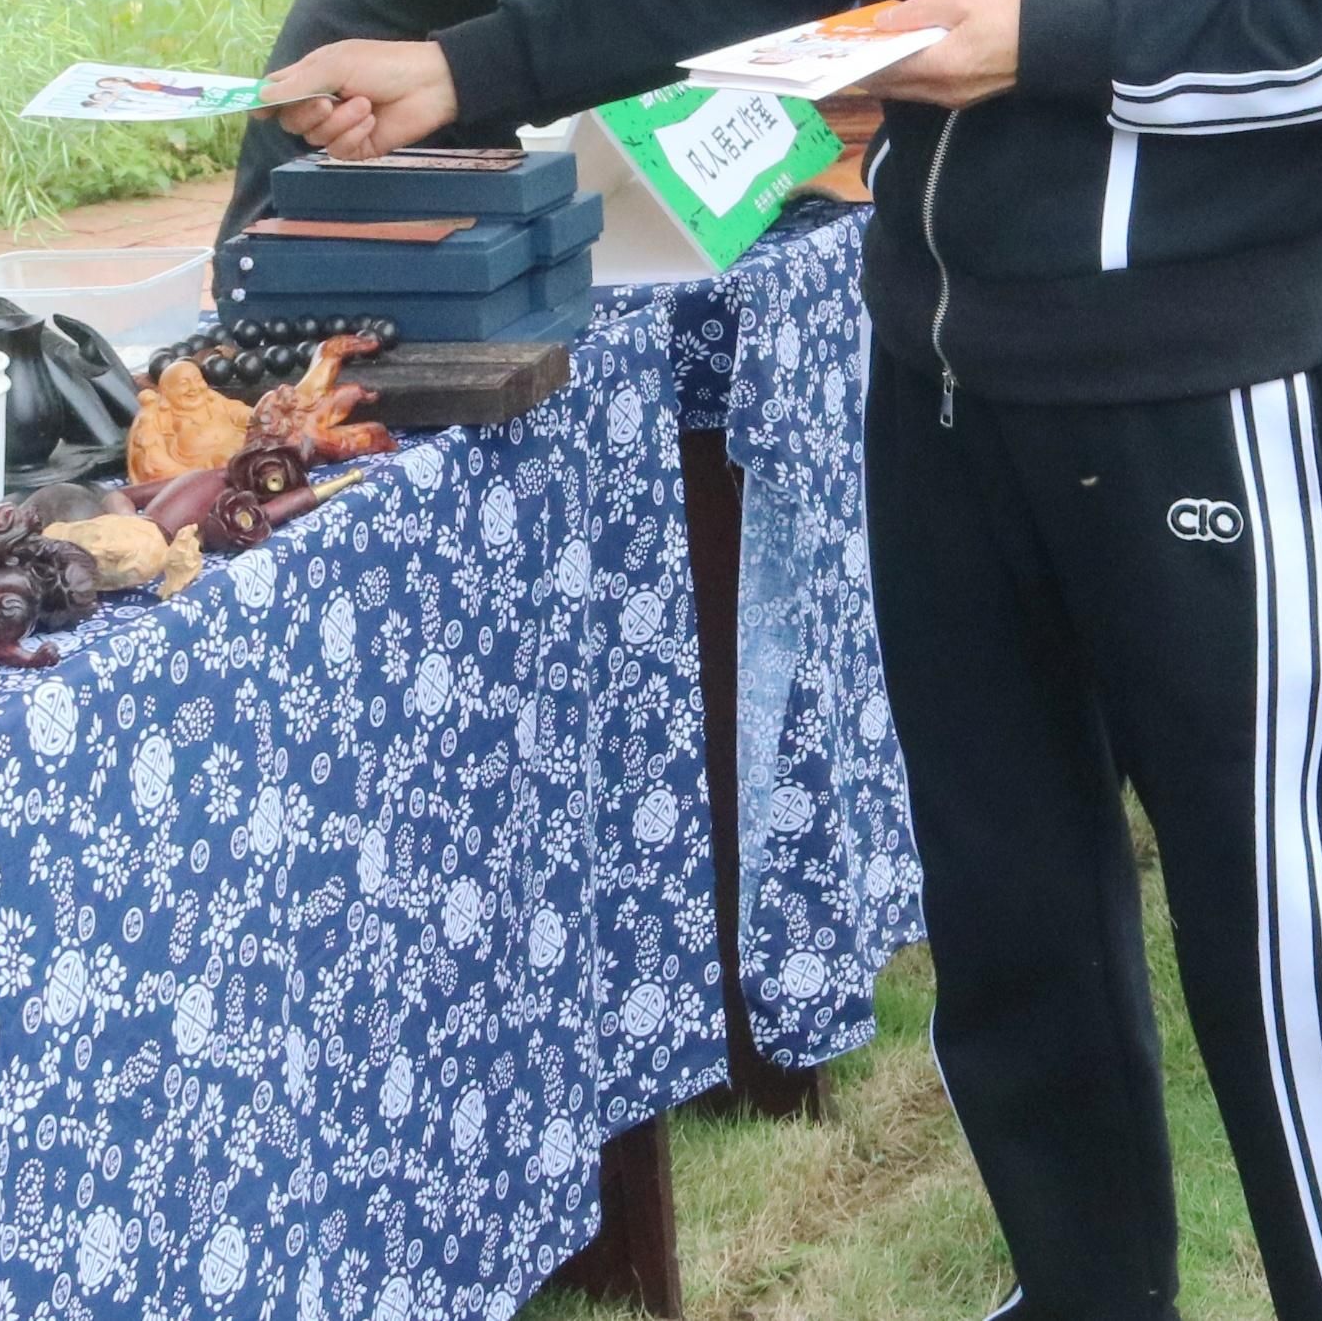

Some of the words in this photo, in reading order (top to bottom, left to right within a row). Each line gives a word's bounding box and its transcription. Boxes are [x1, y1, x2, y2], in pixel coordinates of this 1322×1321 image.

[686, 96, 780, 185] 凡人居工作室
